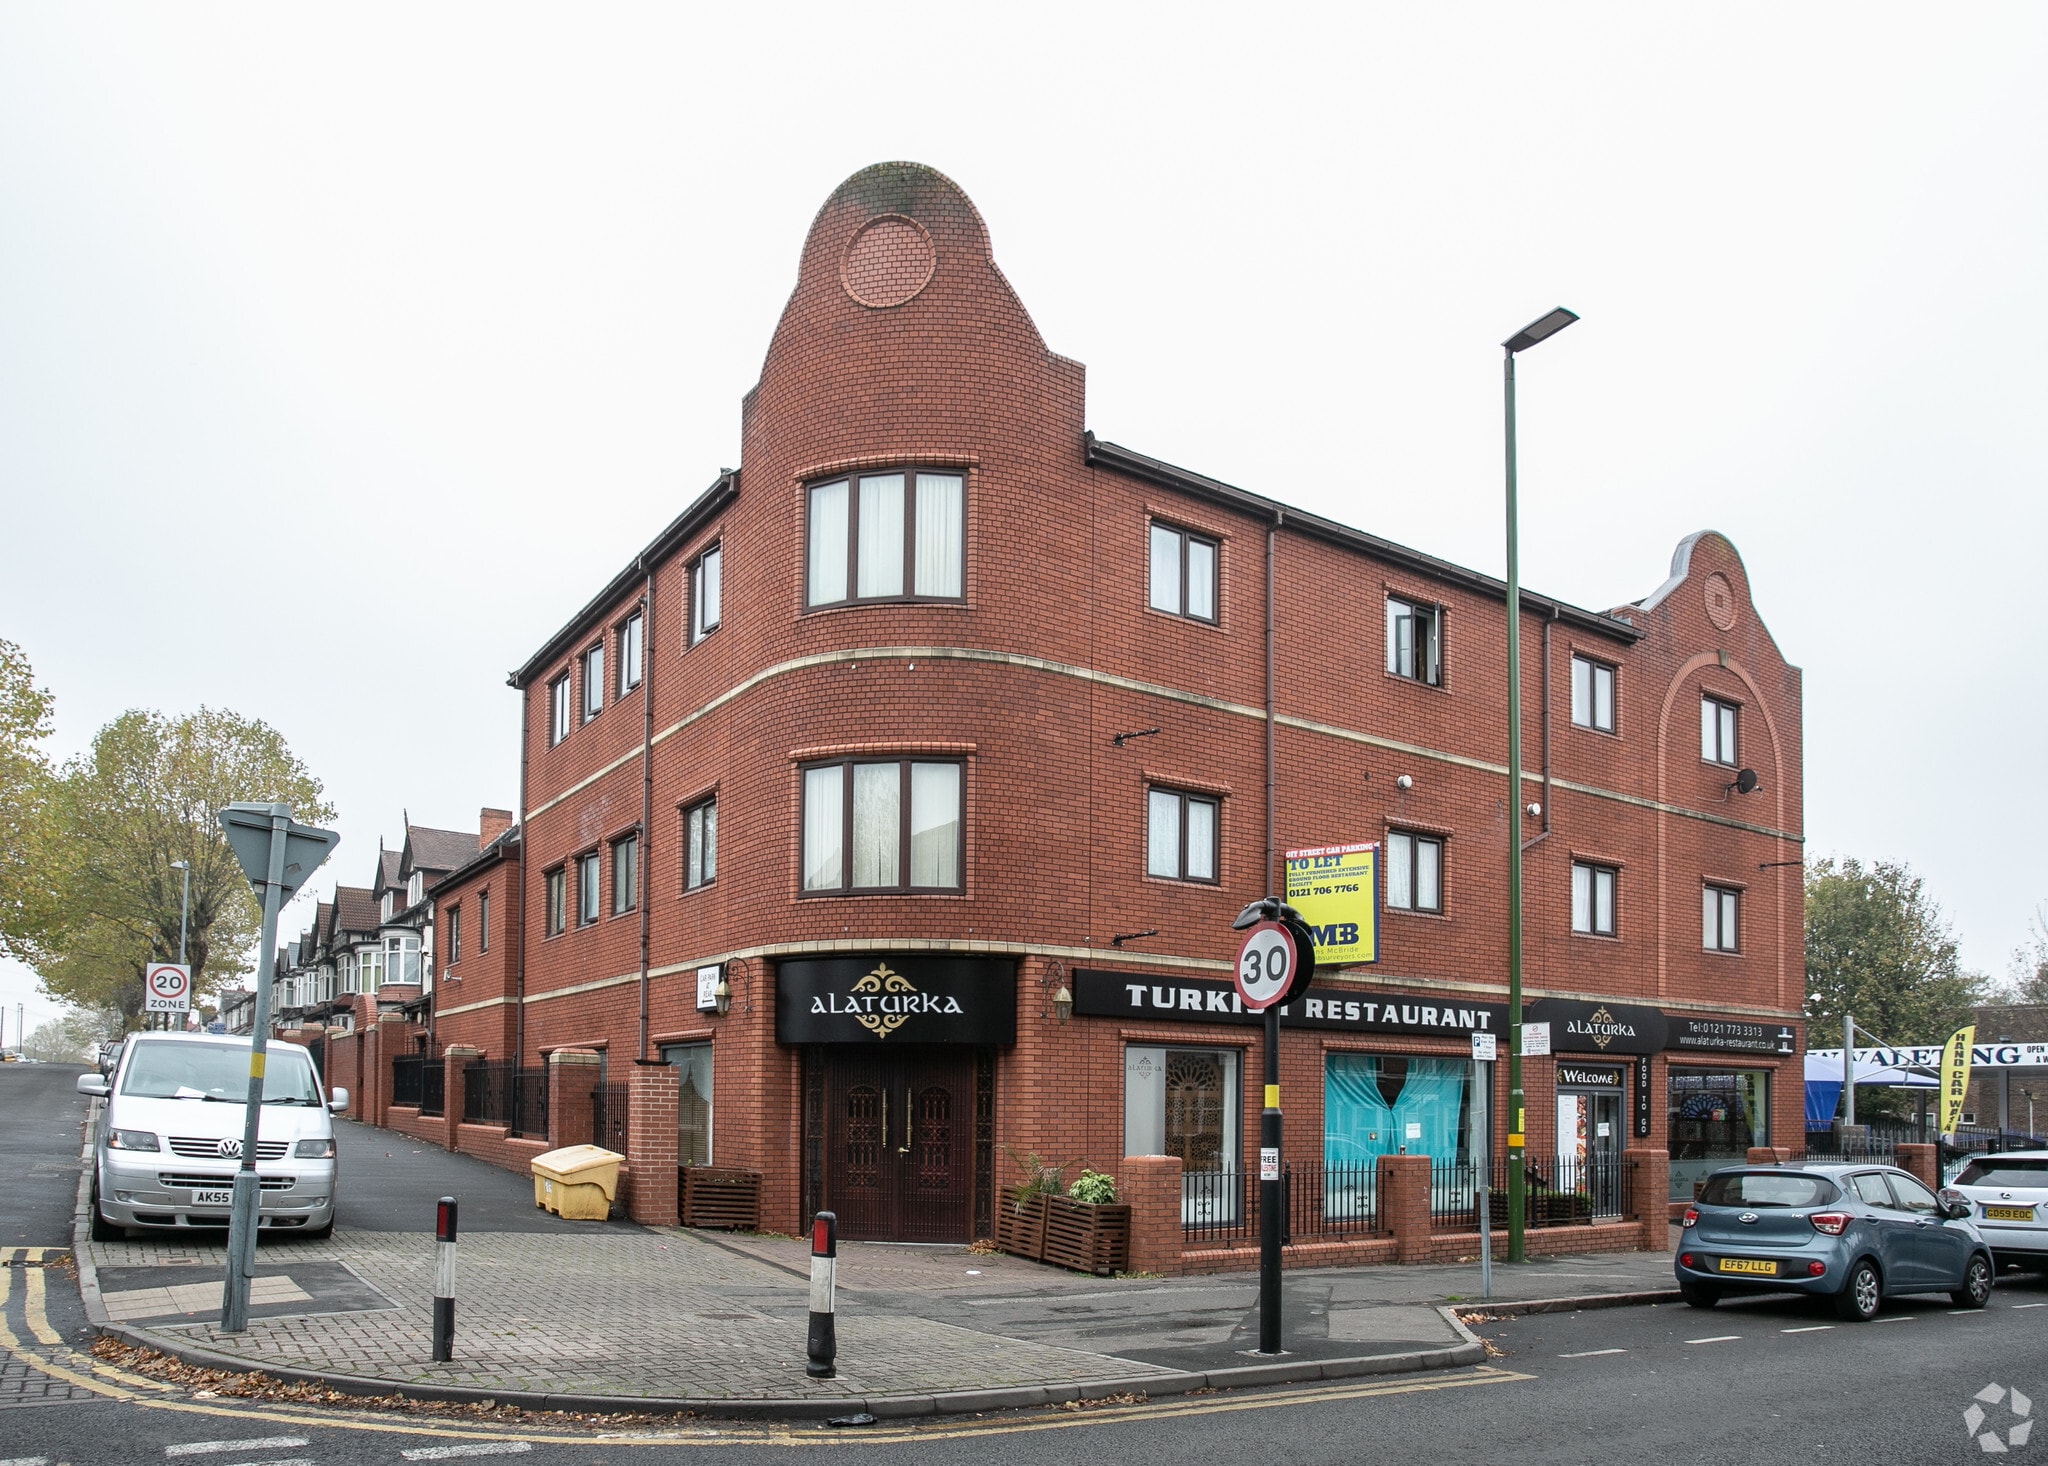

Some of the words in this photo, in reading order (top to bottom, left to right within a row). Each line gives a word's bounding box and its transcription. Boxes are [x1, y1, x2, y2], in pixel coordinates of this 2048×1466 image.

[1326, 846, 1340, 854] CAR
[1341, 843, 1373, 853] PARKING
[1289, 858, 1309, 871] TO
[1314, 855, 1343, 869] LET
[1306, 868, 1337, 876] FURNISHED
[1331, 870, 1368, 878] RESTAURANT
[1289, 889, 1311, 898] 0121
[1313, 886, 1332, 895] 706
[1334, 884, 1359, 893] 7766
[1243, 945, 1287, 985] 30
[156, 975, 182, 989] 20
[150, 1000, 185, 1009] ZONE
[1305, 998, 1491, 1030] RESTAURANT
[1726, 1024, 1741, 1035] 773
[1743, 1026, 1763, 1037] 3313
[1680, 1036, 1776, 1050] www.alaturka-restaurant.co.uk
[1953, 1033, 1965, 1067] HAND
[2027, 1045, 2045, 1053] OPEN
[1951, 1070, 1964, 1096] CAR
[1641, 1096, 1647, 1111] TO
[1641, 1118, 1647, 1133] GO
[197, 1192, 229, 1203] AK55
[1724, 1260, 1750, 1270] EF67
[1751, 1261, 1772, 1272] LLG
